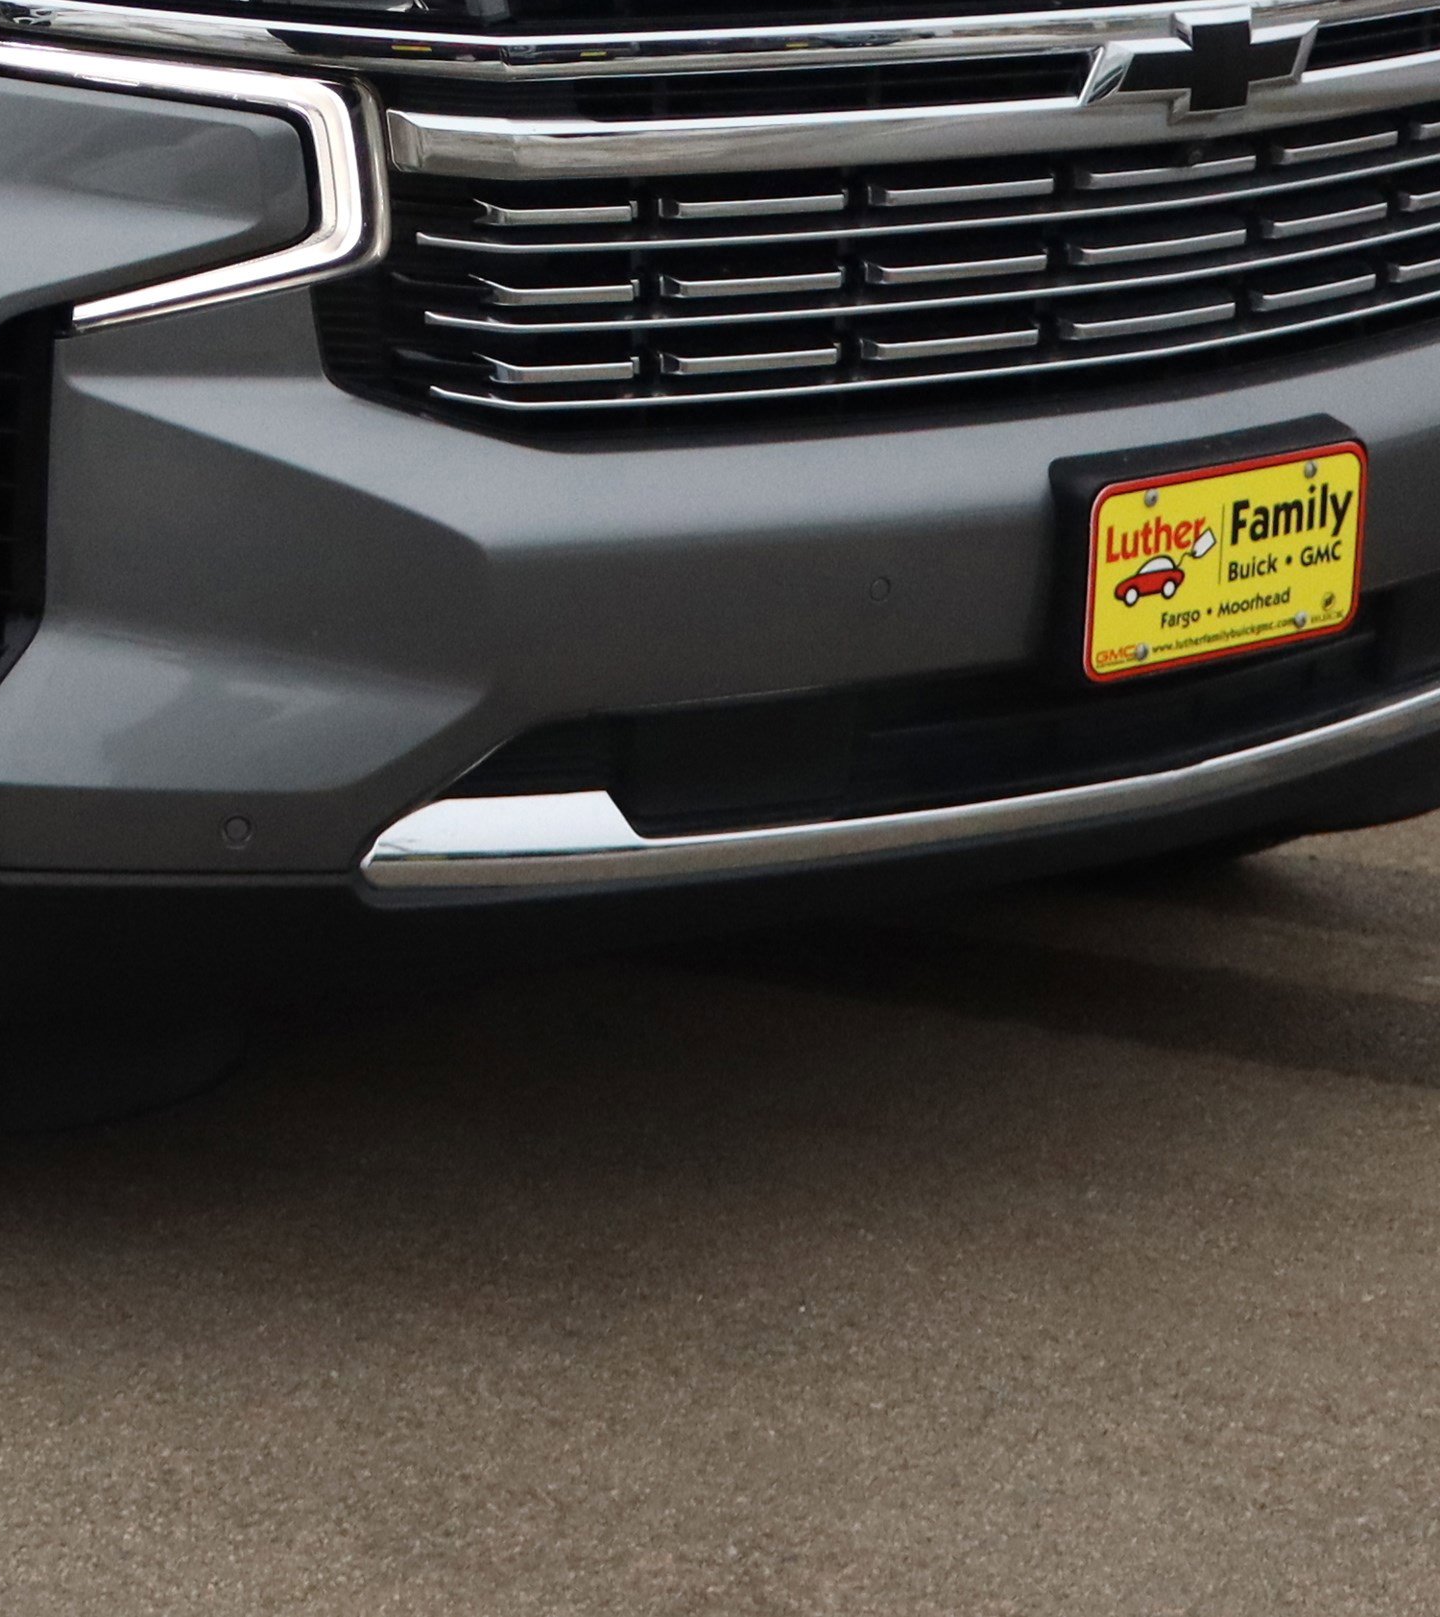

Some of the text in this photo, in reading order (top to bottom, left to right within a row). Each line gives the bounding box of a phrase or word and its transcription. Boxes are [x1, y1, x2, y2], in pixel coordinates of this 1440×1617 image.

[1105, 482, 1354, 564] Luther Family
[1227, 539, 1342, 583] Buick GMC
[1160, 587, 1291, 630] Fargo Moorhead
[1095, 644, 1137, 665] GMC
